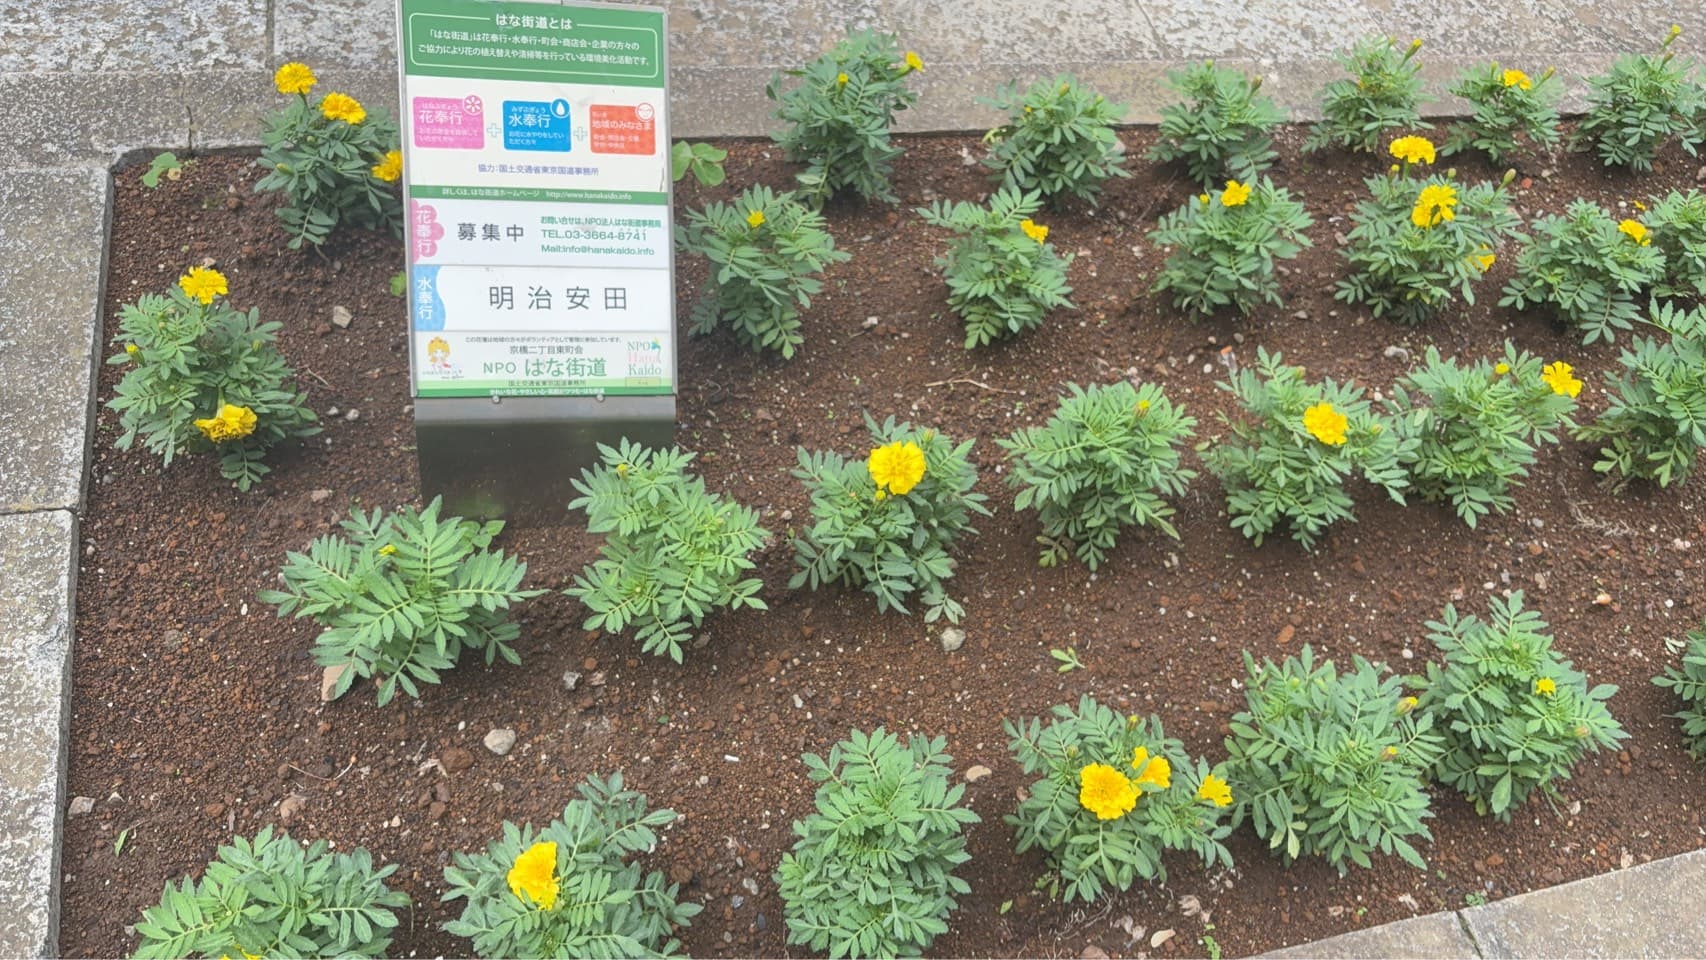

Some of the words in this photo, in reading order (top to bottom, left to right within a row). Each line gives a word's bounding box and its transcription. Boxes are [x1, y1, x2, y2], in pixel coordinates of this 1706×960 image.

[496, 13, 572, 30] はな街道とは
[419, 110, 463, 125] 花奉行
[508, 113, 551, 129] 水奉行
[592, 120, 652, 131] 地域のみなさま
[545, 190, 632, 201] http://www.hanakaido.info
[415, 209, 432, 254] 花奉行
[457, 222, 524, 243] 募集中
[541, 229, 647, 241] TEL.03-3664-8741
[541, 244, 655, 256] Mail:info@hanakaido.info
[417, 277, 433, 320] 水奉行
[488, 285, 627, 311] 明治安田
[510, 345, 583, 355] 京橋二丁目東町会
[627, 341, 650, 351] NPO
[483, 361, 517, 374] NPO
[525, 358, 606, 377] はな街道
[629, 364, 662, 376] Kaido
